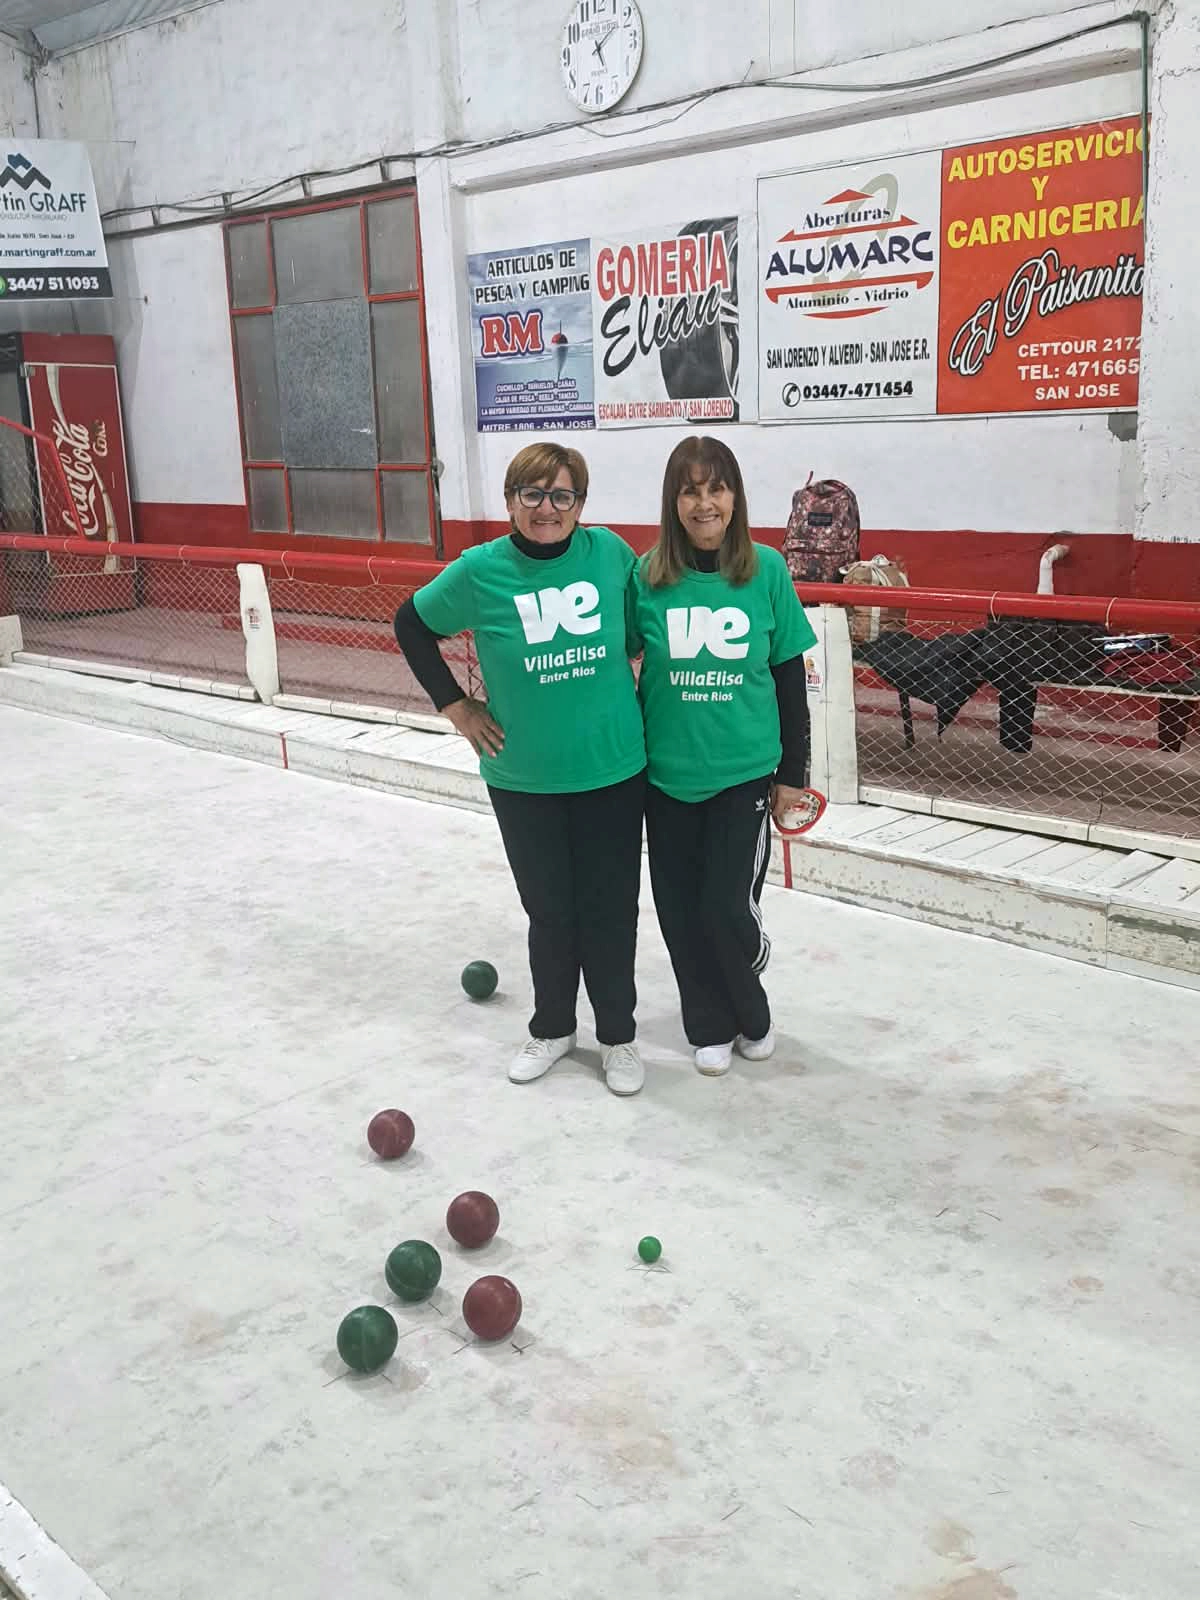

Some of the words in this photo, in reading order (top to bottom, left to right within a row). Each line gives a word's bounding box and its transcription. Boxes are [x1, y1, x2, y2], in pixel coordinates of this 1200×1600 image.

[580, 1, 590, 23] 11
[622, 6, 632, 28] 2
[568, 22, 580, 45] 10
[629, 29, 637, 49] 3
[562, 47, 571, 67] 9
[568, 68, 577, 90] 8
[582, 82, 591, 104] 7
[595, 84, 604, 105] 6
[1031, 175, 1049, 201] Y
[0, 191, 25, 211] tin
[29, 192, 87, 213] GRAFF
[802, 207, 891, 231] Aberturas
[487, 253, 554, 278] ARTICULOS
[560, 250, 576, 268] DE
[766, 231, 934, 280] ALUMARC
[596, 232, 729, 302] GOMERIA
[7, 277, 44, 292] 3447
[475, 284, 513, 304] PESCA
[519, 282, 527, 299] Y
[532, 274, 590, 297] CAMPING
[1004, 248, 1144, 338] Paisanito
[786, 294, 849, 310] Aluminio
[864, 287, 909, 303] Vidrio
[481, 312, 543, 357] RM
[600, 284, 721, 377] Elian
[949, 289, 1002, 377] El
[766, 349, 782, 369] SAN
[784, 346, 819, 368] LORENZO
[821, 345, 827, 366] Y
[828, 343, 863, 366] ALVERDI
[870, 341, 888, 363] SAN
[889, 339, 912, 362] JOSE
[1018, 339, 1097, 358] CETTOUR
[1017, 364, 1060, 381] TEL:
[1065, 358, 1140, 378] 471665
[803, 381, 914, 399] 03447-471454
[1035, 386, 1070, 400] SAN
[1075, 383, 1120, 398] JOSE
[599, 403, 627, 420] ESCALADA
[628, 402, 647, 419] ENTRE
[648, 401, 682, 418] SARMIENTO
[682, 401, 689, 419] Y
[689, 400, 702, 417] SAN
[703, 399, 733, 417] LORENZO
[543, 421, 564, 430] SAN
[566, 419, 593, 429] JOSE
[523, 644, 607, 673] VillaElisa
[539, 671, 570, 685] Entre
[669, 670, 744, 687] VillaElisa
[681, 691, 709, 702] Entre
